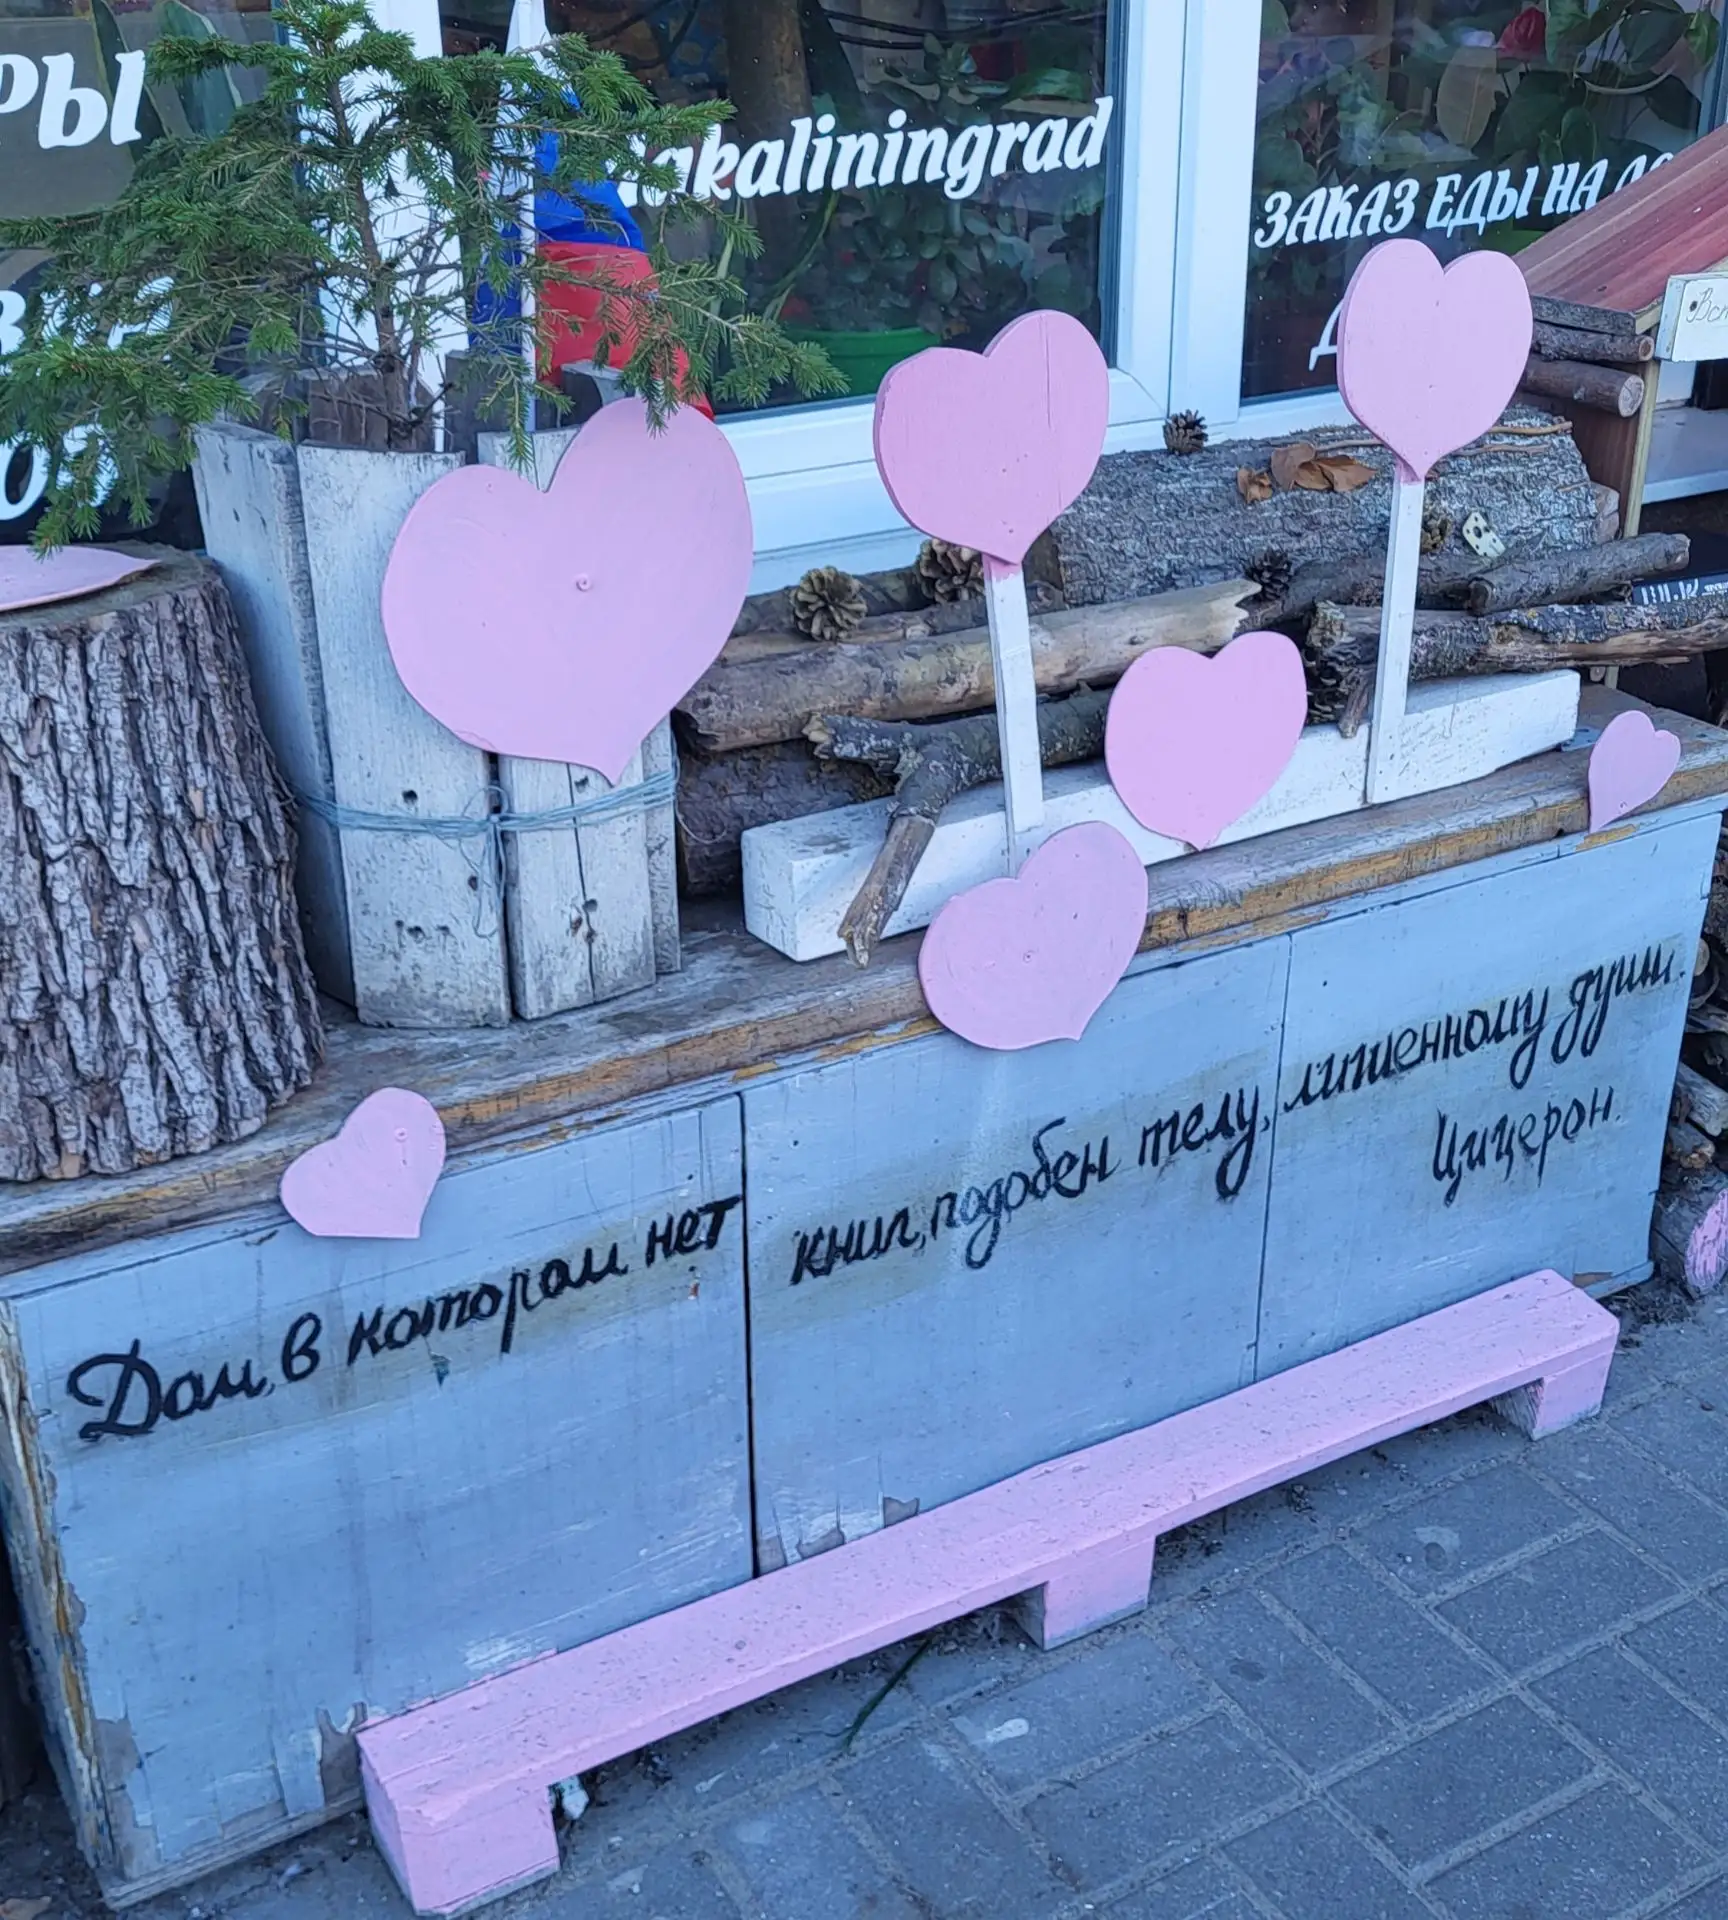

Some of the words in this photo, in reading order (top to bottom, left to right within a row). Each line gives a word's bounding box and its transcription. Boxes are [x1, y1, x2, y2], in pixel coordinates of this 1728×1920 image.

[1254, 178, 1419, 248] ЗАКАЗ
[1425, 167, 1539, 238] ЕДЫ
[1541, 158, 1609, 216] НА
[281, 1311, 322, 1382] в
[347, 1242, 629, 1367] котором
[645, 1194, 743, 1268] нет
[930, 1116, 1121, 1270] подобен
[1137, 1085, 1271, 1201] телу,
[1283, 986, 1549, 1113] лишенному
